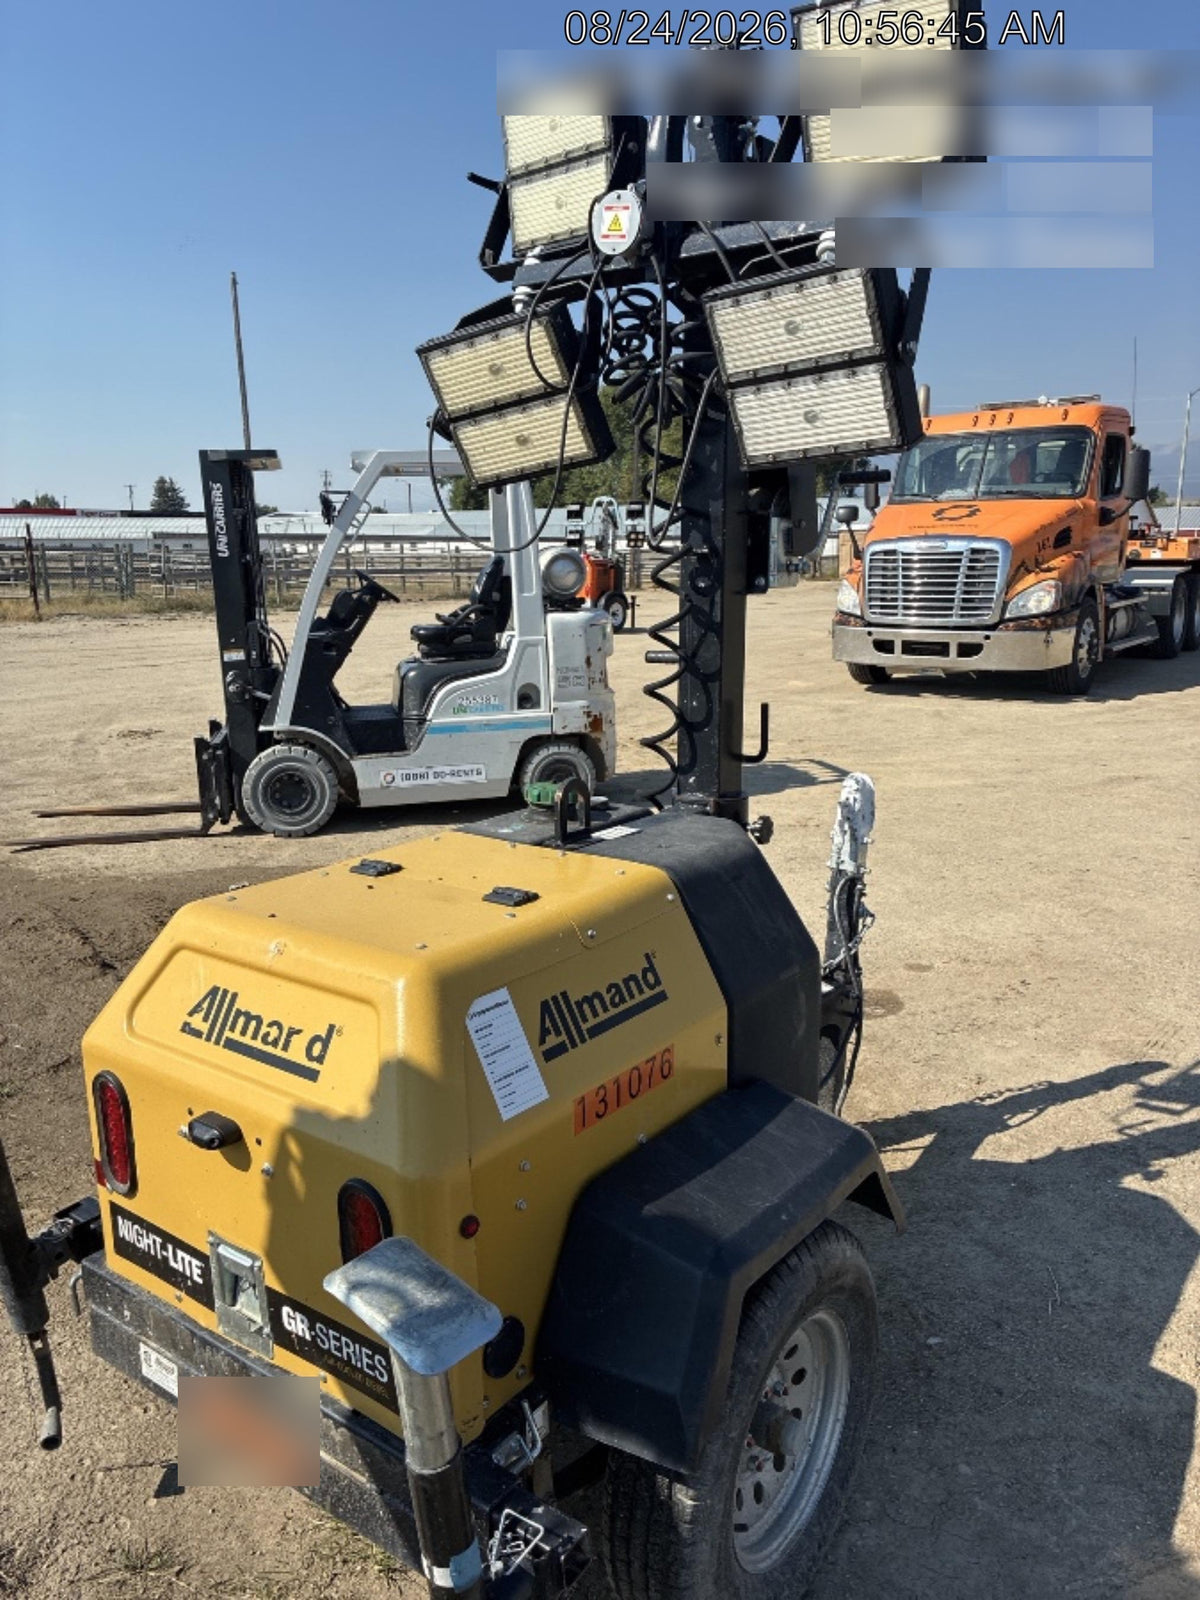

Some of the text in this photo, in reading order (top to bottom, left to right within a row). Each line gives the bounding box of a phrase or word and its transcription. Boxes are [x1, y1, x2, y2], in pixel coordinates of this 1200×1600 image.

[538, 951, 663, 1049] Allmand
[577, 1047, 674, 1128] 131076
[117, 1215, 204, 1285] NIGHT-LITE
